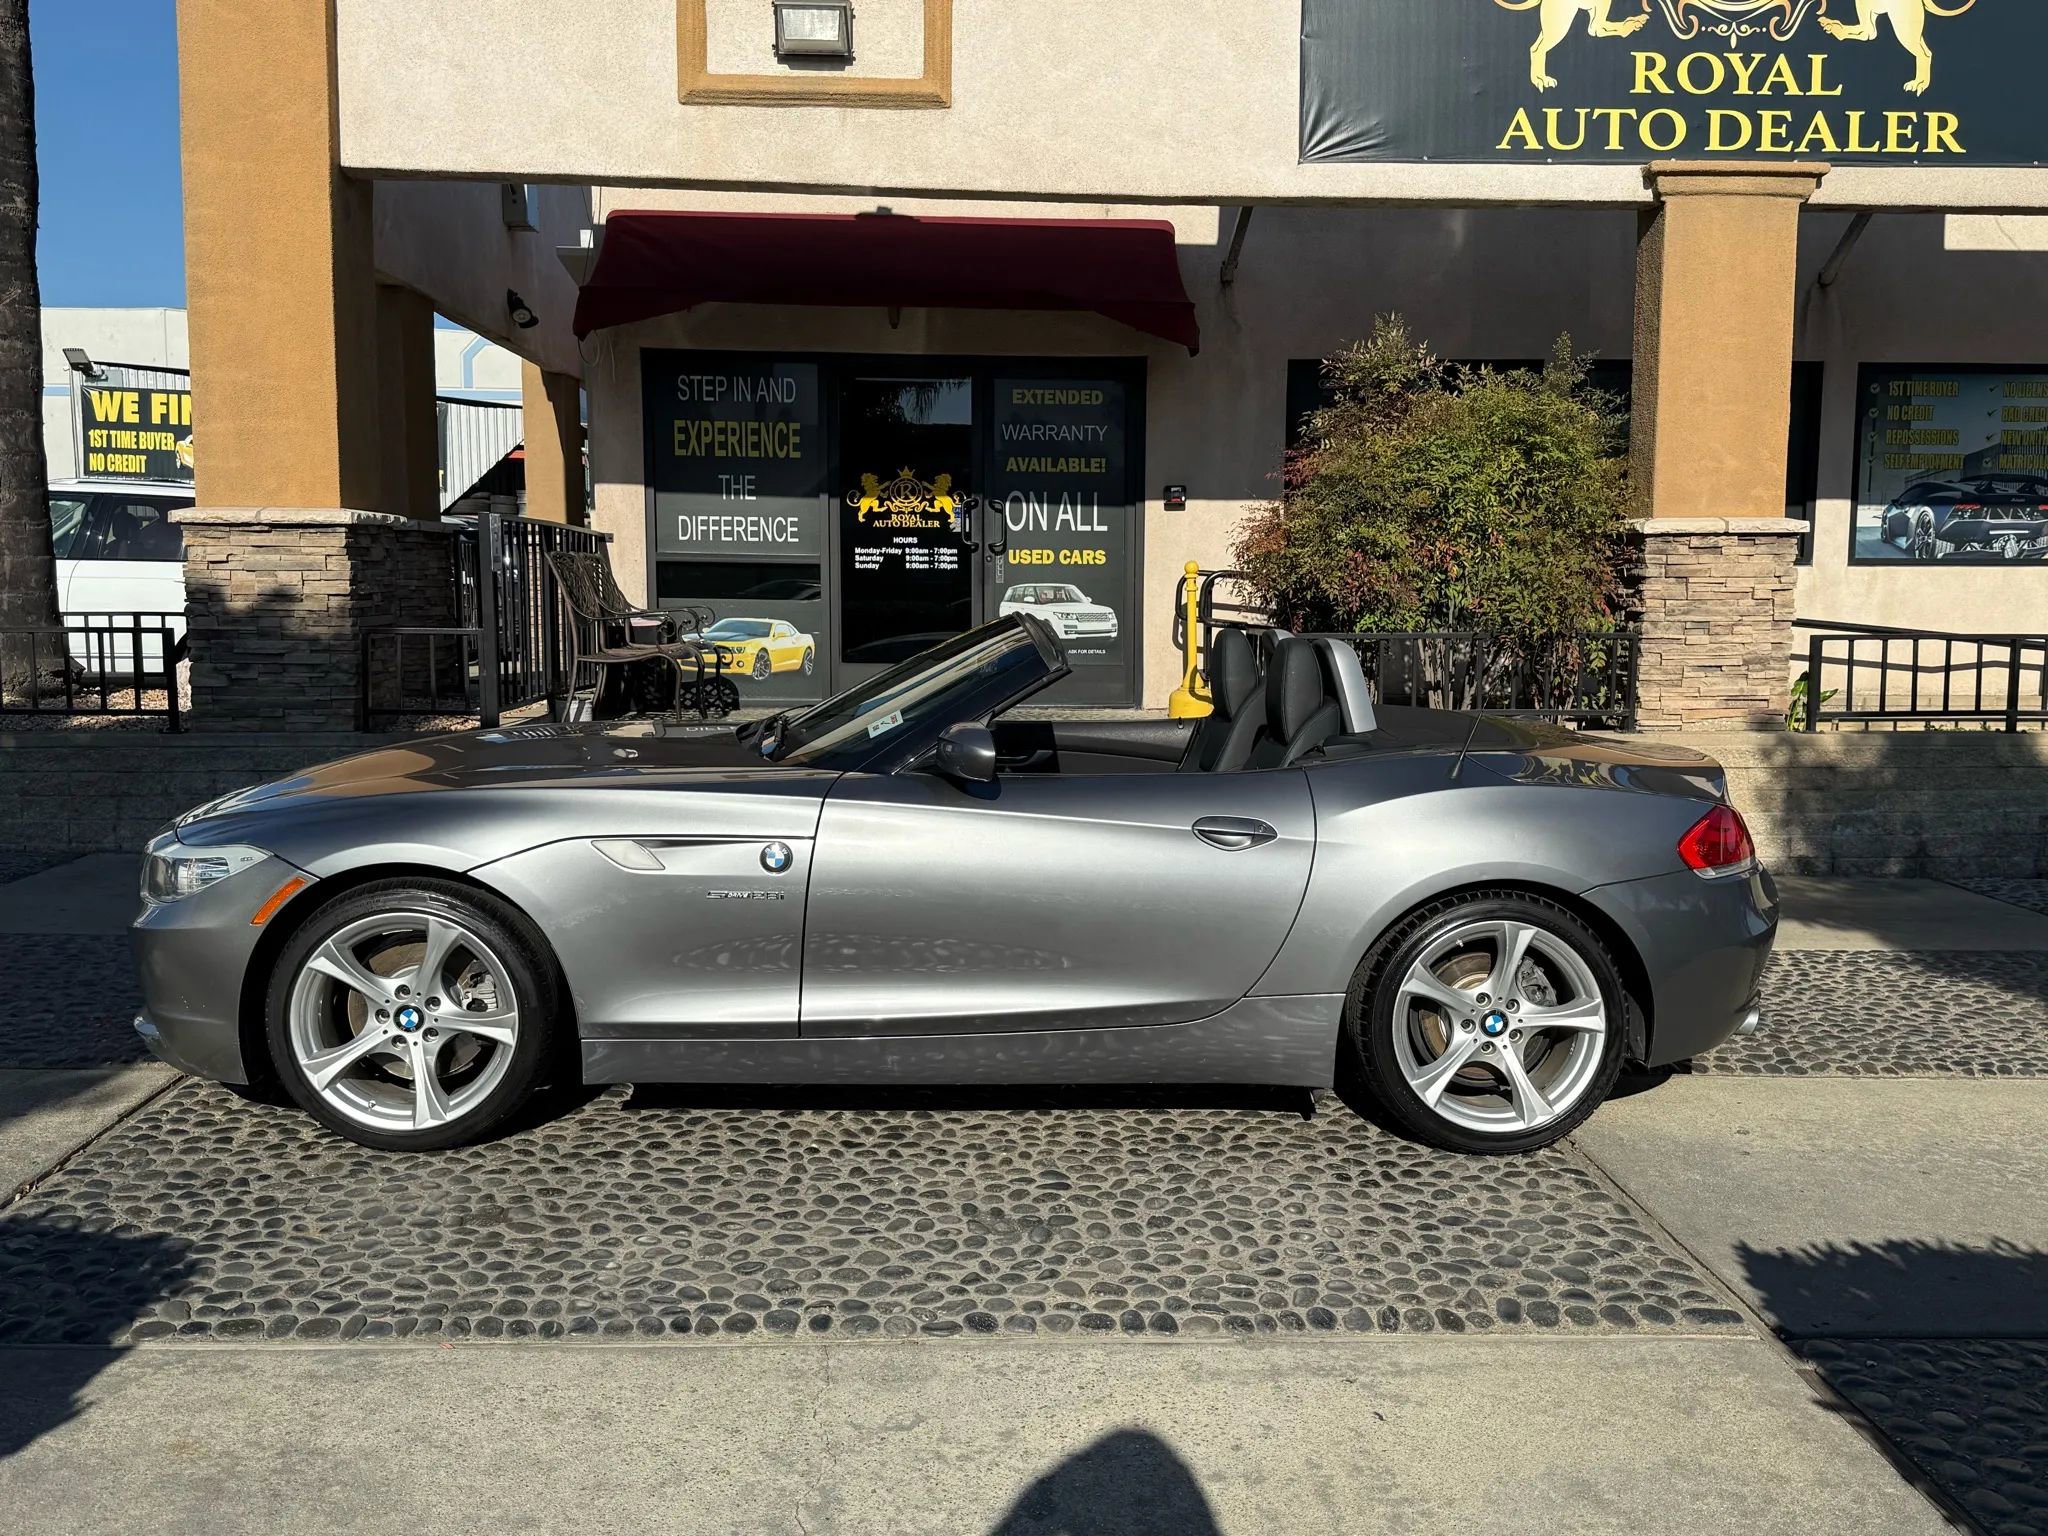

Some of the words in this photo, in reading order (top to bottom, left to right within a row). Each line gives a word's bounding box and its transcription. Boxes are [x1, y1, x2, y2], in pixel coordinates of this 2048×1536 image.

[1629, 51, 1843, 96] ROYAL
[1495, 107, 1687, 151] AUTO
[1704, 109, 1967, 153] DEALER
[677, 375, 727, 401] STEP
[733, 376, 751, 402] IN
[755, 377, 796, 403] AND
[1012, 389, 1104, 405] EXTENDED
[90, 390, 140, 423] WE
[1887, 405, 1900, 420] NO
[1902, 405, 1934, 420] CREDIT
[88, 429, 109, 448] 1ST
[109, 430, 137, 450] TIME
[139, 432, 175, 451] BUYER
[673, 420, 801, 458] EXPERIENCE
[1002, 424, 1108, 441] WARRANTY
[89, 453, 105, 472] NO
[107, 454, 147, 473] CREDIT
[1006, 457, 1106, 473] AVAILABLE!
[718, 475, 757, 500] THE
[1005, 490, 1047, 531] ON
[1055, 491, 1108, 531] ALL
[678, 515, 799, 542] DIFFERENCE
[873, 520, 900, 528] AUTO
[902, 520, 940, 528] DEALER
[854, 547, 903, 555] Monday-Friday
[854, 555, 884, 563] Saturday
[1008, 549, 1055, 565] USED
[1059, 549, 1107, 565] CARS
[854, 562, 880, 570] Sunday
